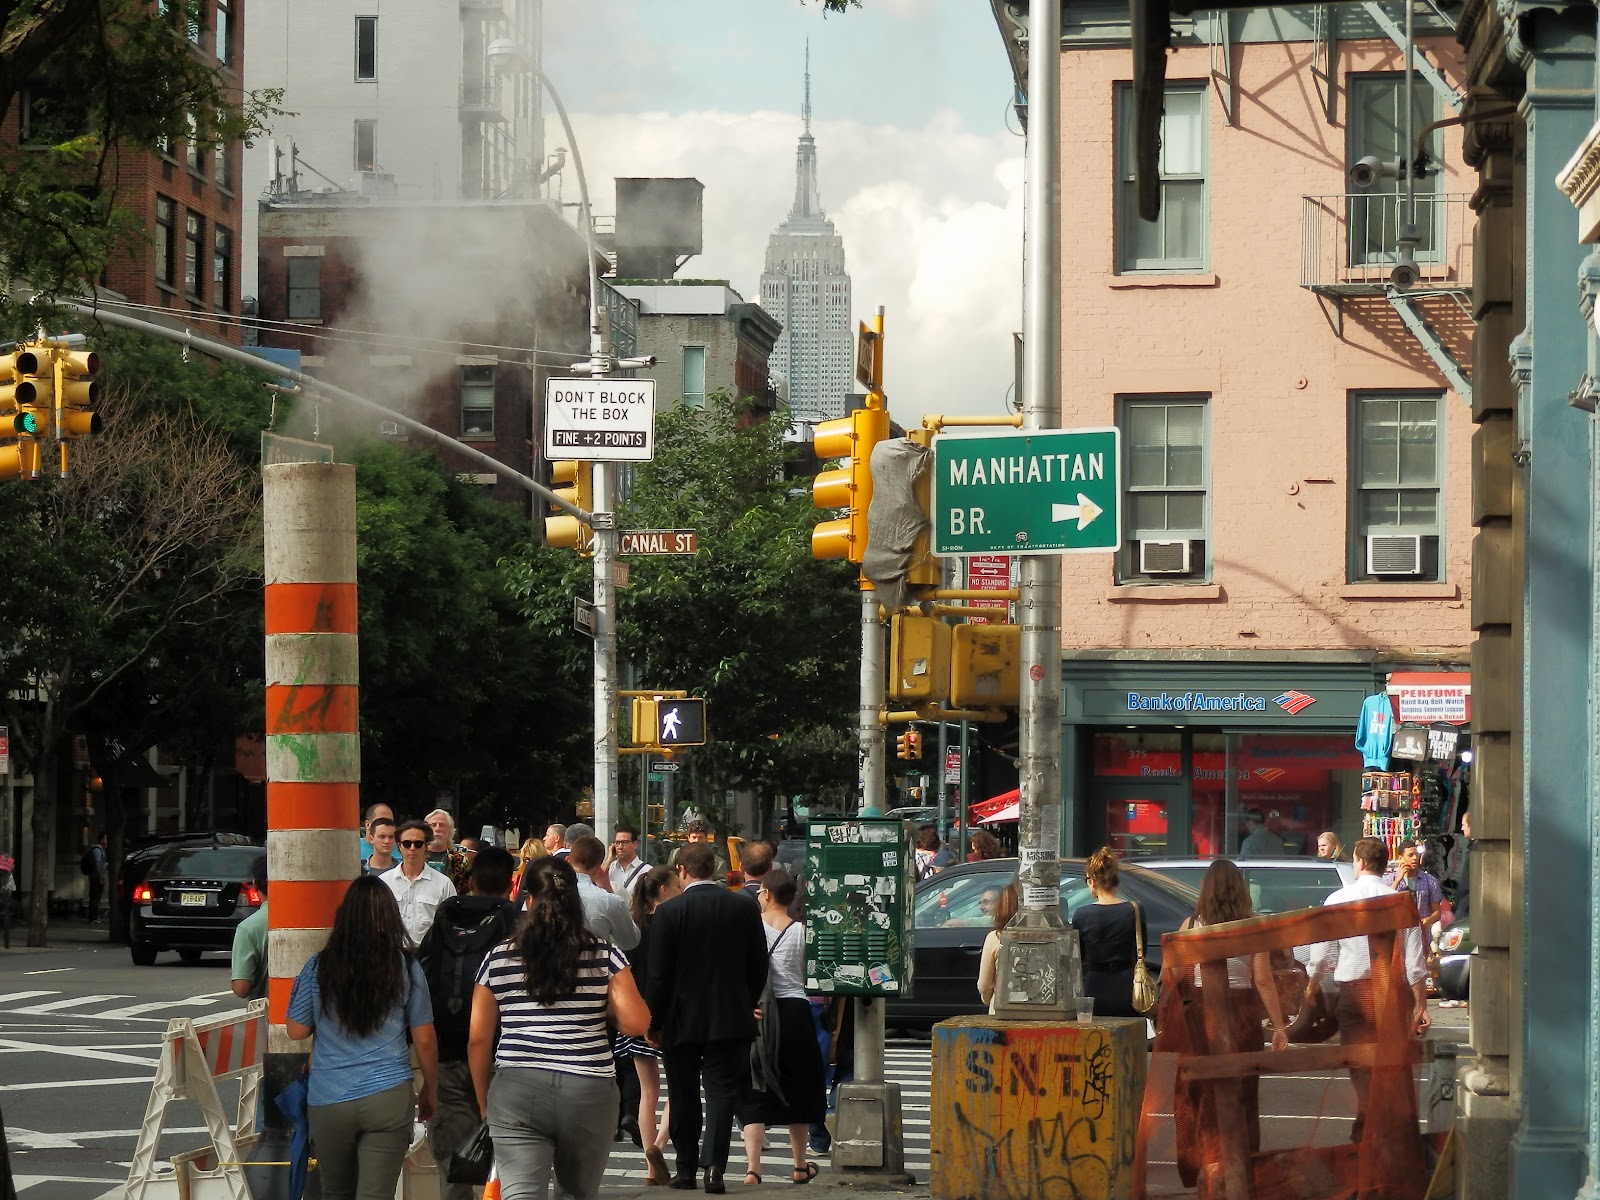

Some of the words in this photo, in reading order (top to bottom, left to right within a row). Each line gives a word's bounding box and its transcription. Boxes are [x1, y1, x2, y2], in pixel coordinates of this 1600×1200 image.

[555, 391, 595, 403] DON'T
[600, 392, 646, 404] BLOCK
[571, 407, 597, 420] THE
[602, 408, 629, 420] BOX
[556, 431, 579, 445] FINE
[583, 432, 601, 445] +2
[604, 432, 643, 446] POINTS
[949, 452, 1104, 487] MANHATTAN
[949, 507, 992, 536] BR.
[621, 533, 669, 553] CANAL
[675, 533, 693, 552] ST
[971, 578, 980, 586] NO
[981, 578, 1007, 587] STANDING
[1400, 689, 1464, 698] PERFUME
[1127, 692, 1172, 710] Bank
[1174, 693, 1192, 710] of
[1193, 693, 1266, 711] America
[1369, 722, 1386, 736] NY
[1428, 729, 1442, 741] NEW
[1442, 731, 1458, 744] YORK
[1129, 750, 1147, 759] 375
[1432, 748, 1450, 760] CITY
[1141, 766, 1176, 776] Bank
[1026, 850, 1056, 861] MISSING
[965, 1050, 1080, 1097] S.N.T.
